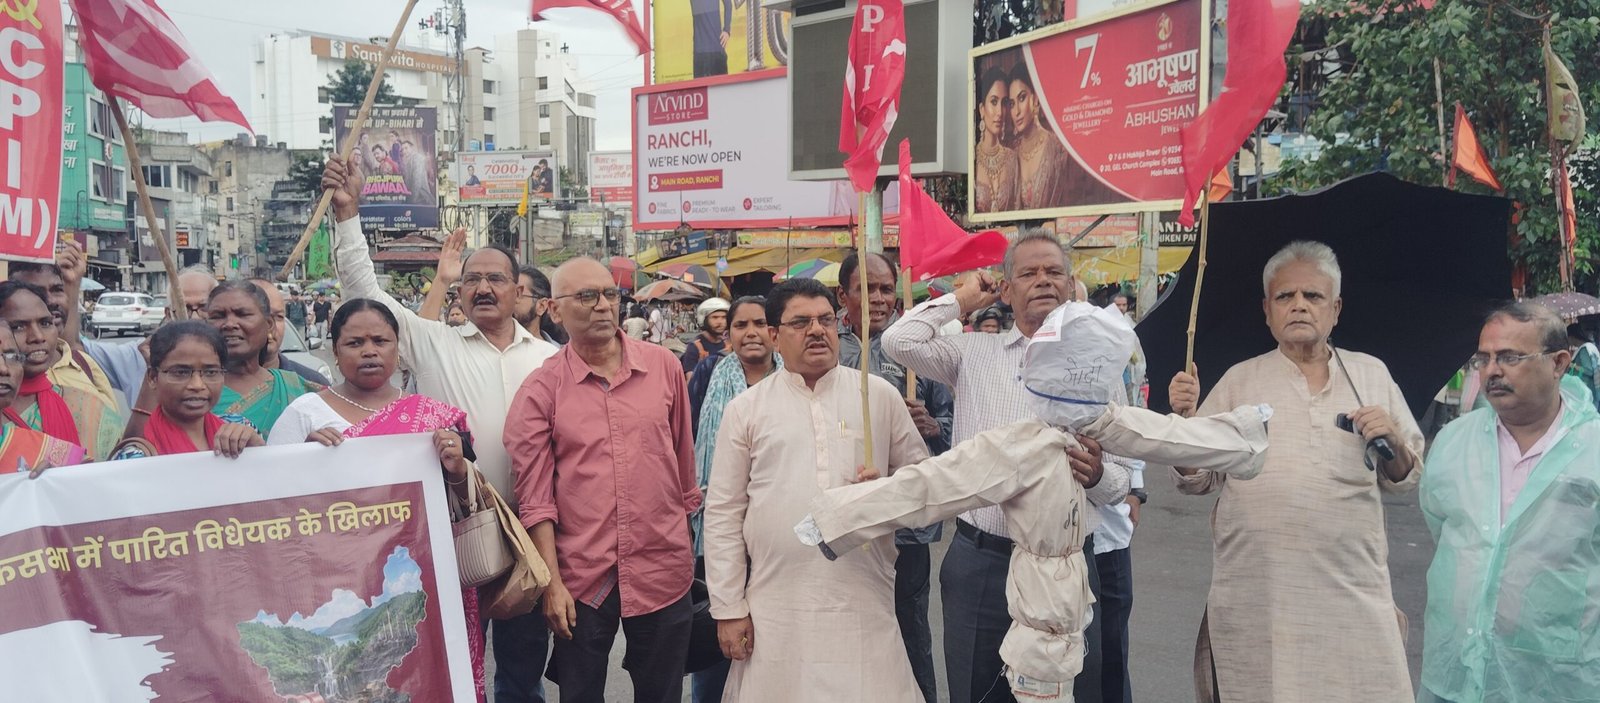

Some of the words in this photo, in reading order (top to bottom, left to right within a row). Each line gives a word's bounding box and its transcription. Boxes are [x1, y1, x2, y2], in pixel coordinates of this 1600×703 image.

[352, 44, 414, 66] Santvita
[415, 62, 452, 73] HOSPITAL
[1125, 49, 1198, 88] आभूषण
[666, 111, 691, 121] STORE
[1062, 113, 1078, 122] GOLD
[1084, 107, 1113, 118] DIAMOND
[1124, 103, 1195, 128] ABHUSHAN
[648, 129, 712, 150] RANCHI,
[682, 153, 707, 166] NOW
[711, 150, 742, 163] OPEN
[484, 164, 528, 175] 7000+
[661, 178, 675, 186] MAIN
[675, 176, 695, 185] ROAD,
[695, 175, 720, 184] RANCHI
[72, 535, 104, 568] में
[108, 527, 188, 564] पारित
[193, 518, 291, 552] विधेयक
[295, 508, 322, 536] के
[326, 500, 411, 534] खिलाफ
